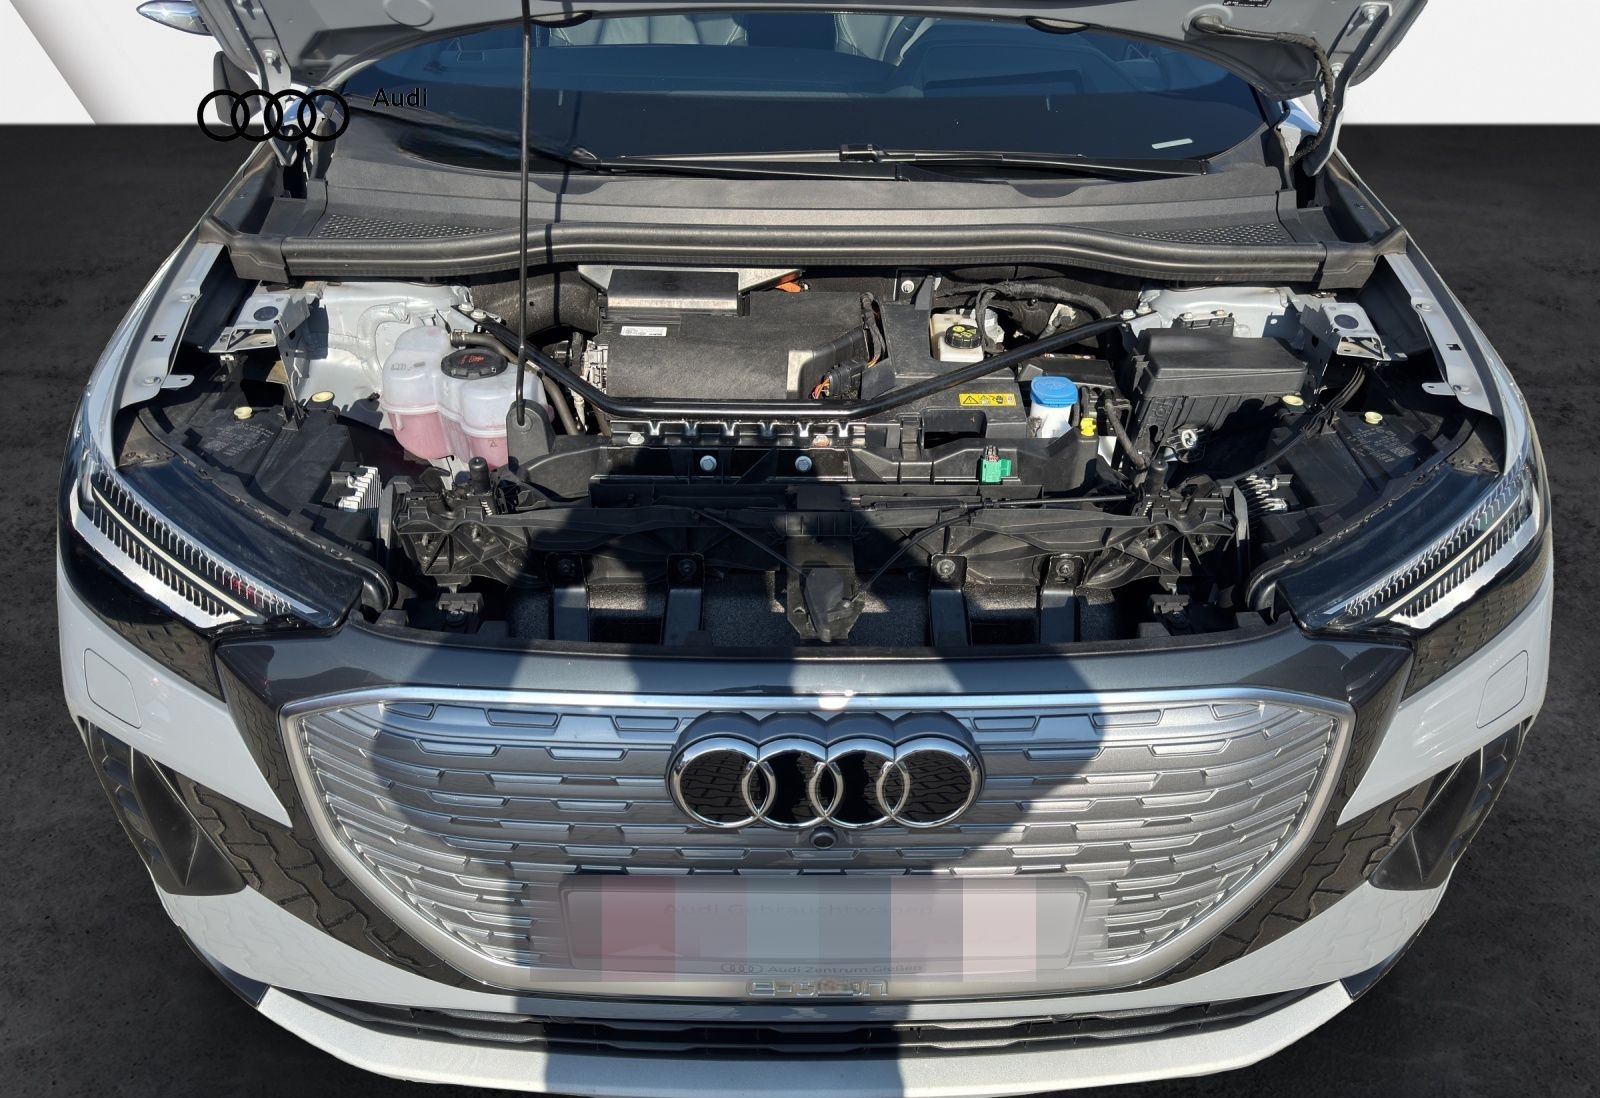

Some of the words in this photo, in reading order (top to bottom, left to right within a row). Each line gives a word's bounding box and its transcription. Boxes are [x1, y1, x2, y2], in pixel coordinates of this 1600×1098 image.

[661, 903, 719, 915] Audi
[727, 903, 934, 918] Gebrauchtwagen
[767, 966, 801, 974] Audi
[805, 966, 868, 975] Zentrum
[872, 964, 922, 973] Gießen
